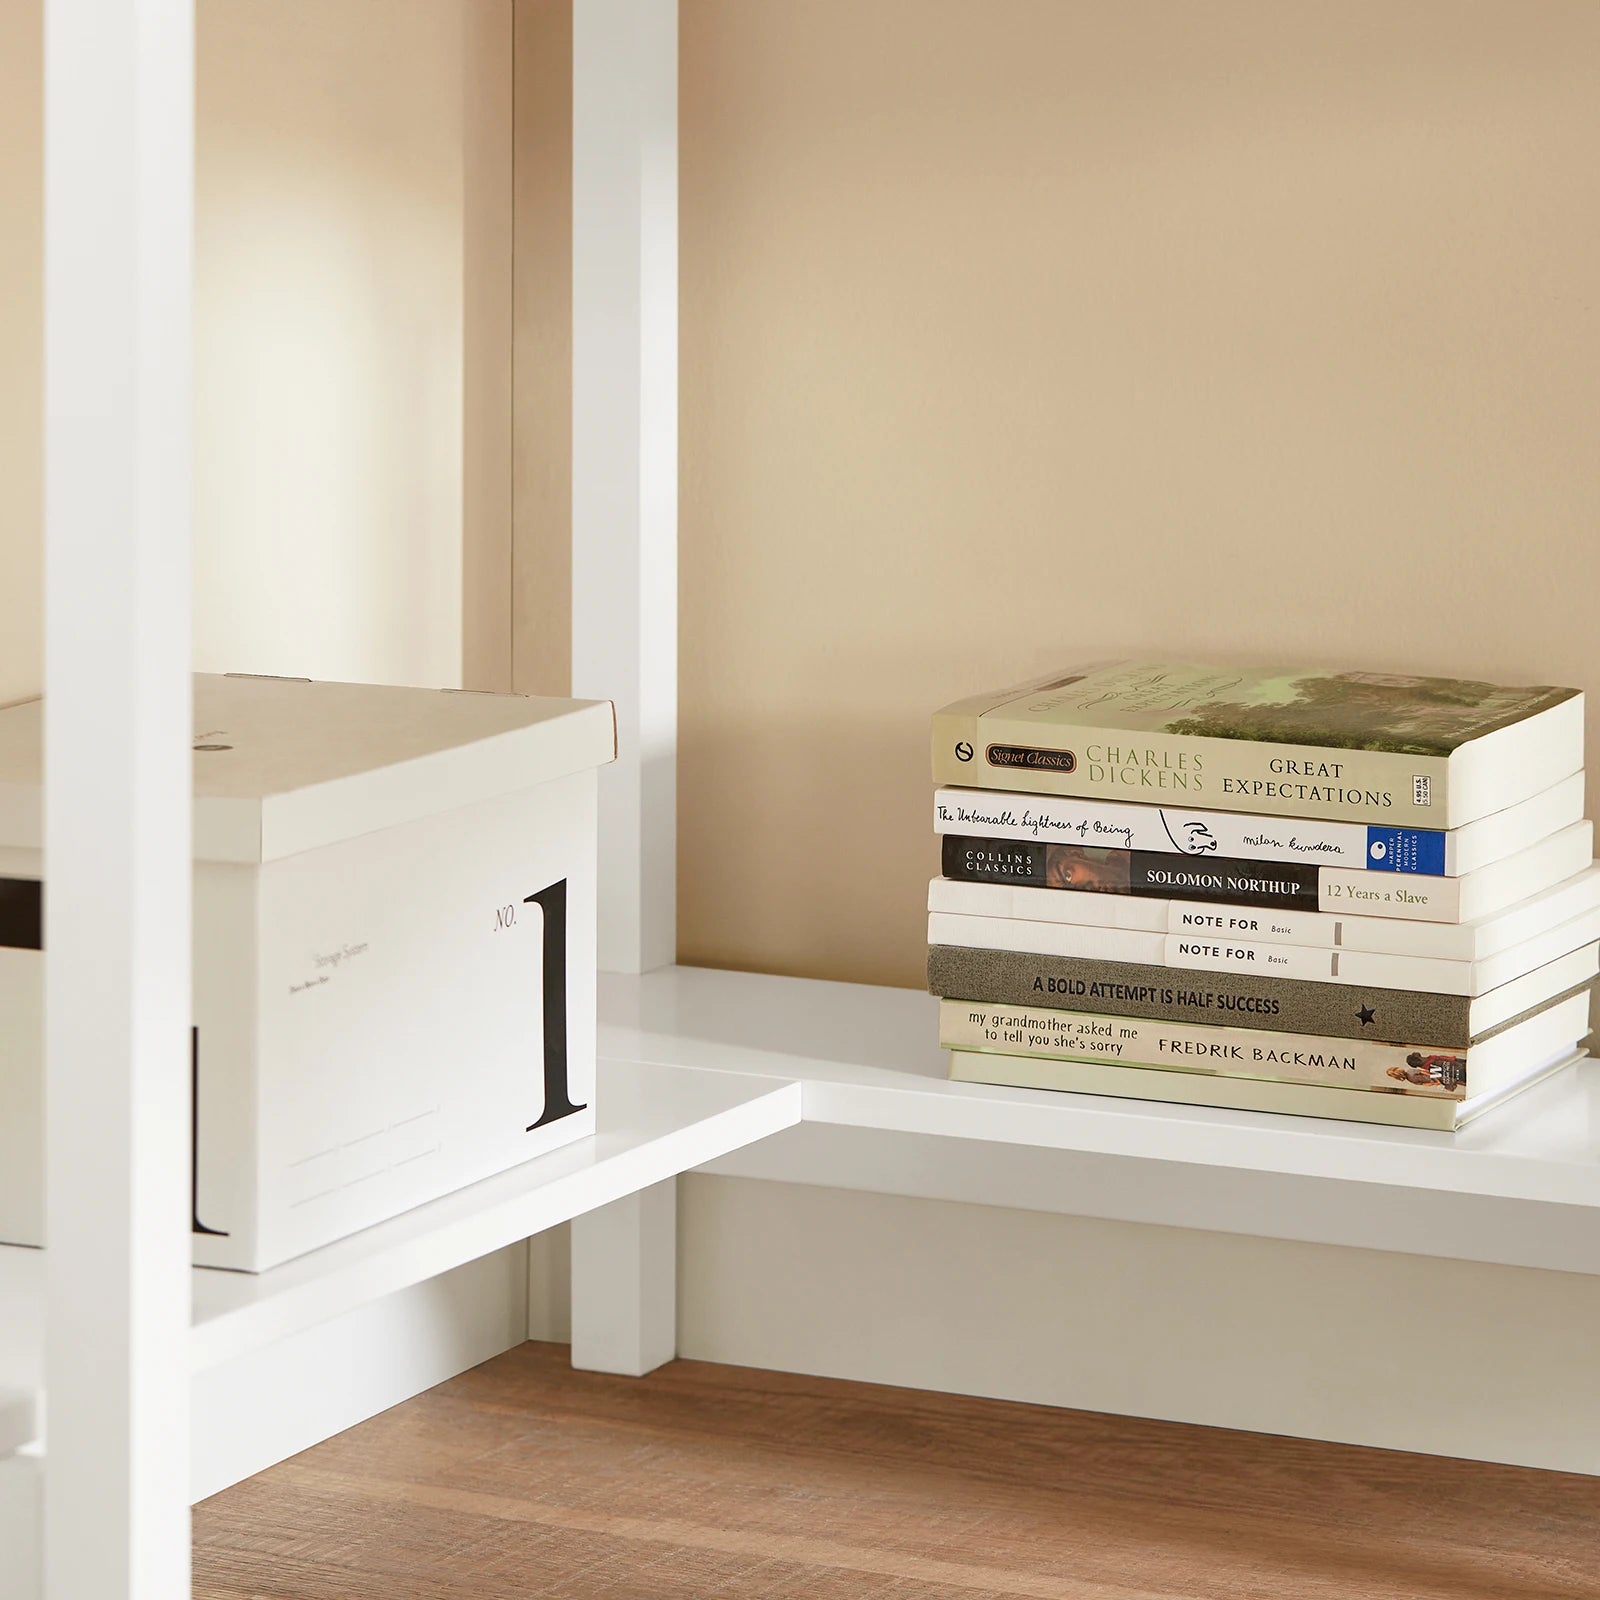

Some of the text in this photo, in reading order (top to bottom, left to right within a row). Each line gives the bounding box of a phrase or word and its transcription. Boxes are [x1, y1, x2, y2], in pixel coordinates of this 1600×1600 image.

[991, 748, 1072, 768] Signet Classics
[1086, 744, 1203, 771] CHARLES
[1269, 758, 1344, 778] GREAT
[1089, 764, 1203, 791] DICKENS
[1222, 778, 1393, 807] EXPECTATIONS
[936, 805, 1135, 848] The Unbearable Lightness of Being
[966, 850, 1033, 865] COLLINS
[1243, 833, 1345, 855] milan kundera
[1395, 831, 1403, 872] PERENNIAL
[966, 861, 1033, 875] CLASSICS
[1146, 869, 1301, 896] SOLOMON NORTHUP
[1327, 884, 1429, 905] 12 Years a Slave
[1182, 914, 1292, 935] NOTE FOR Basic
[1179, 943, 1289, 965] NOTE FOR Basic
[493, 878, 588, 1132] NO. 1
[1033, 976, 1280, 1015] A BOLD ATTEMPT IS HALF SUCCESS
[968, 1012, 1138, 1040] my grandmother asked me
[984, 1028, 1123, 1056] to tell you she's sorry
[1158, 1039, 1356, 1071] FREDRIK BACKMAN
